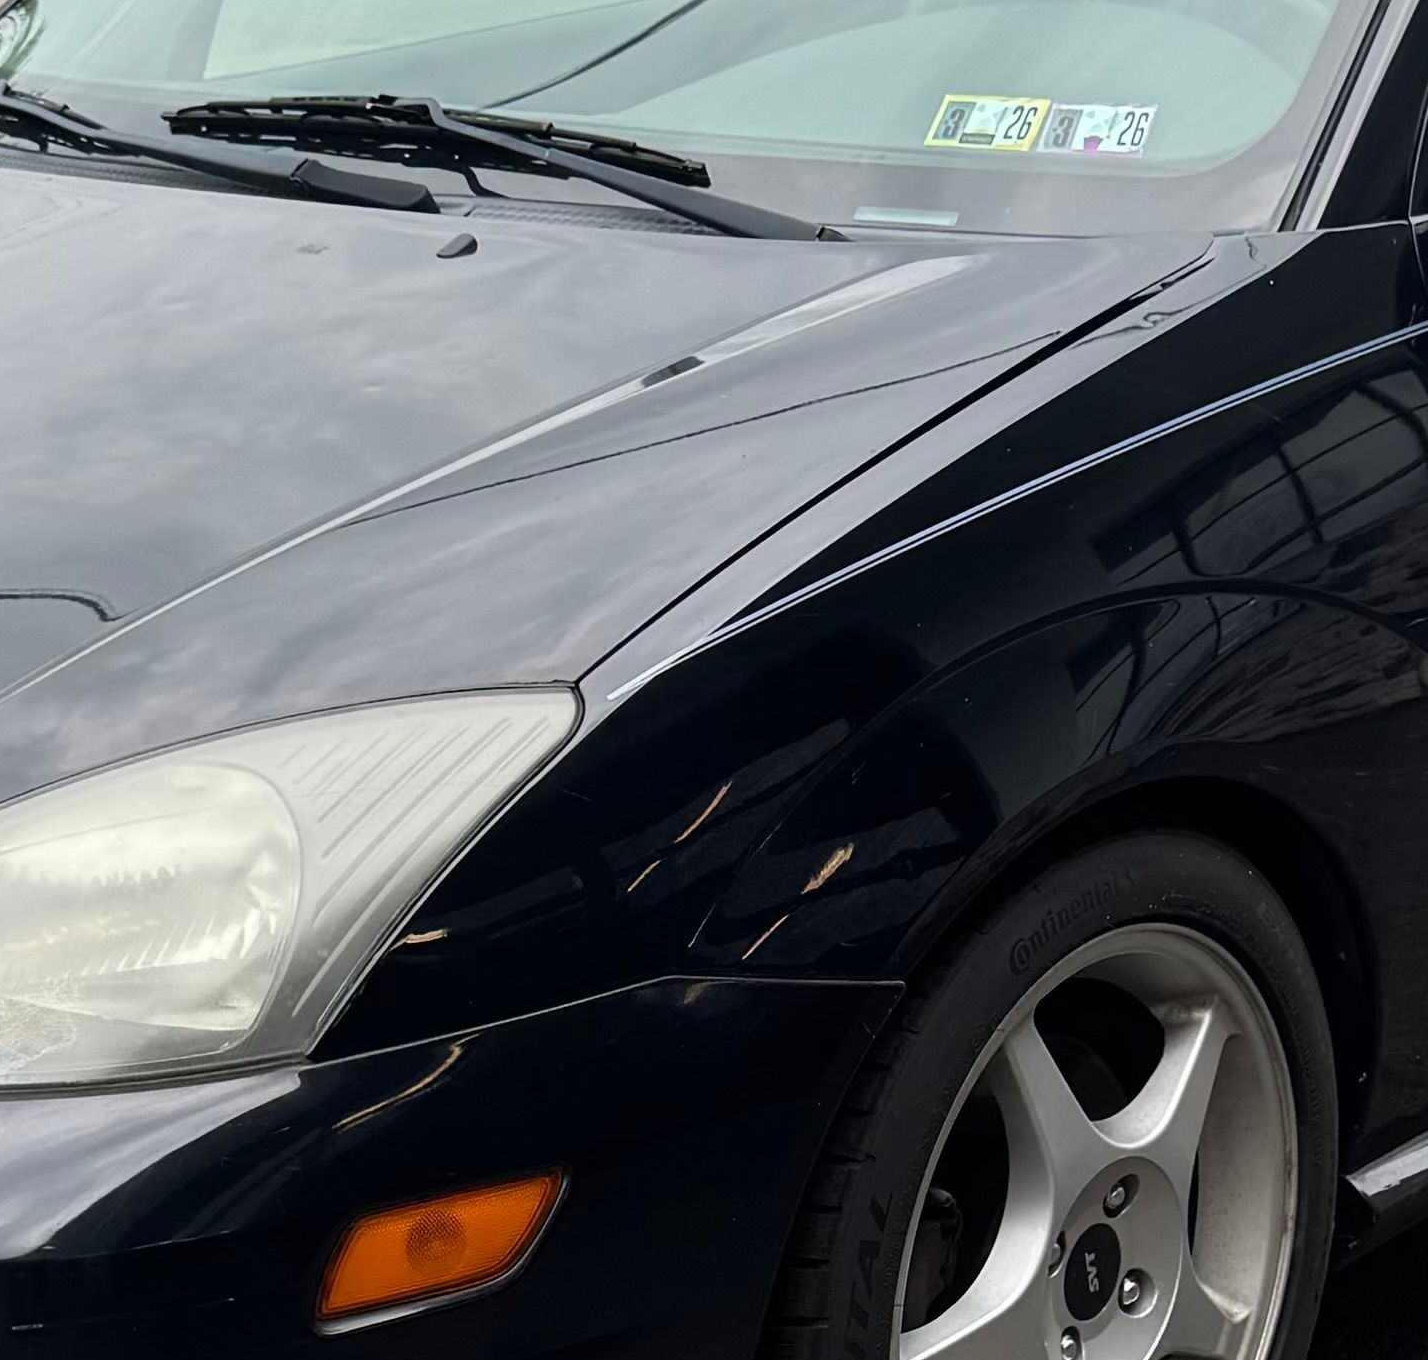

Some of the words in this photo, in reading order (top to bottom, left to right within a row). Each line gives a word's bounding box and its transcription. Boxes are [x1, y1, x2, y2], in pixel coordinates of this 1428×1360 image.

[941, 108, 966, 139] 3
[1003, 105, 1039, 141] 26
[1051, 115, 1075, 147] 3
[1116, 111, 1150, 147] 26
[1084, 1251, 1100, 1294] SVT
